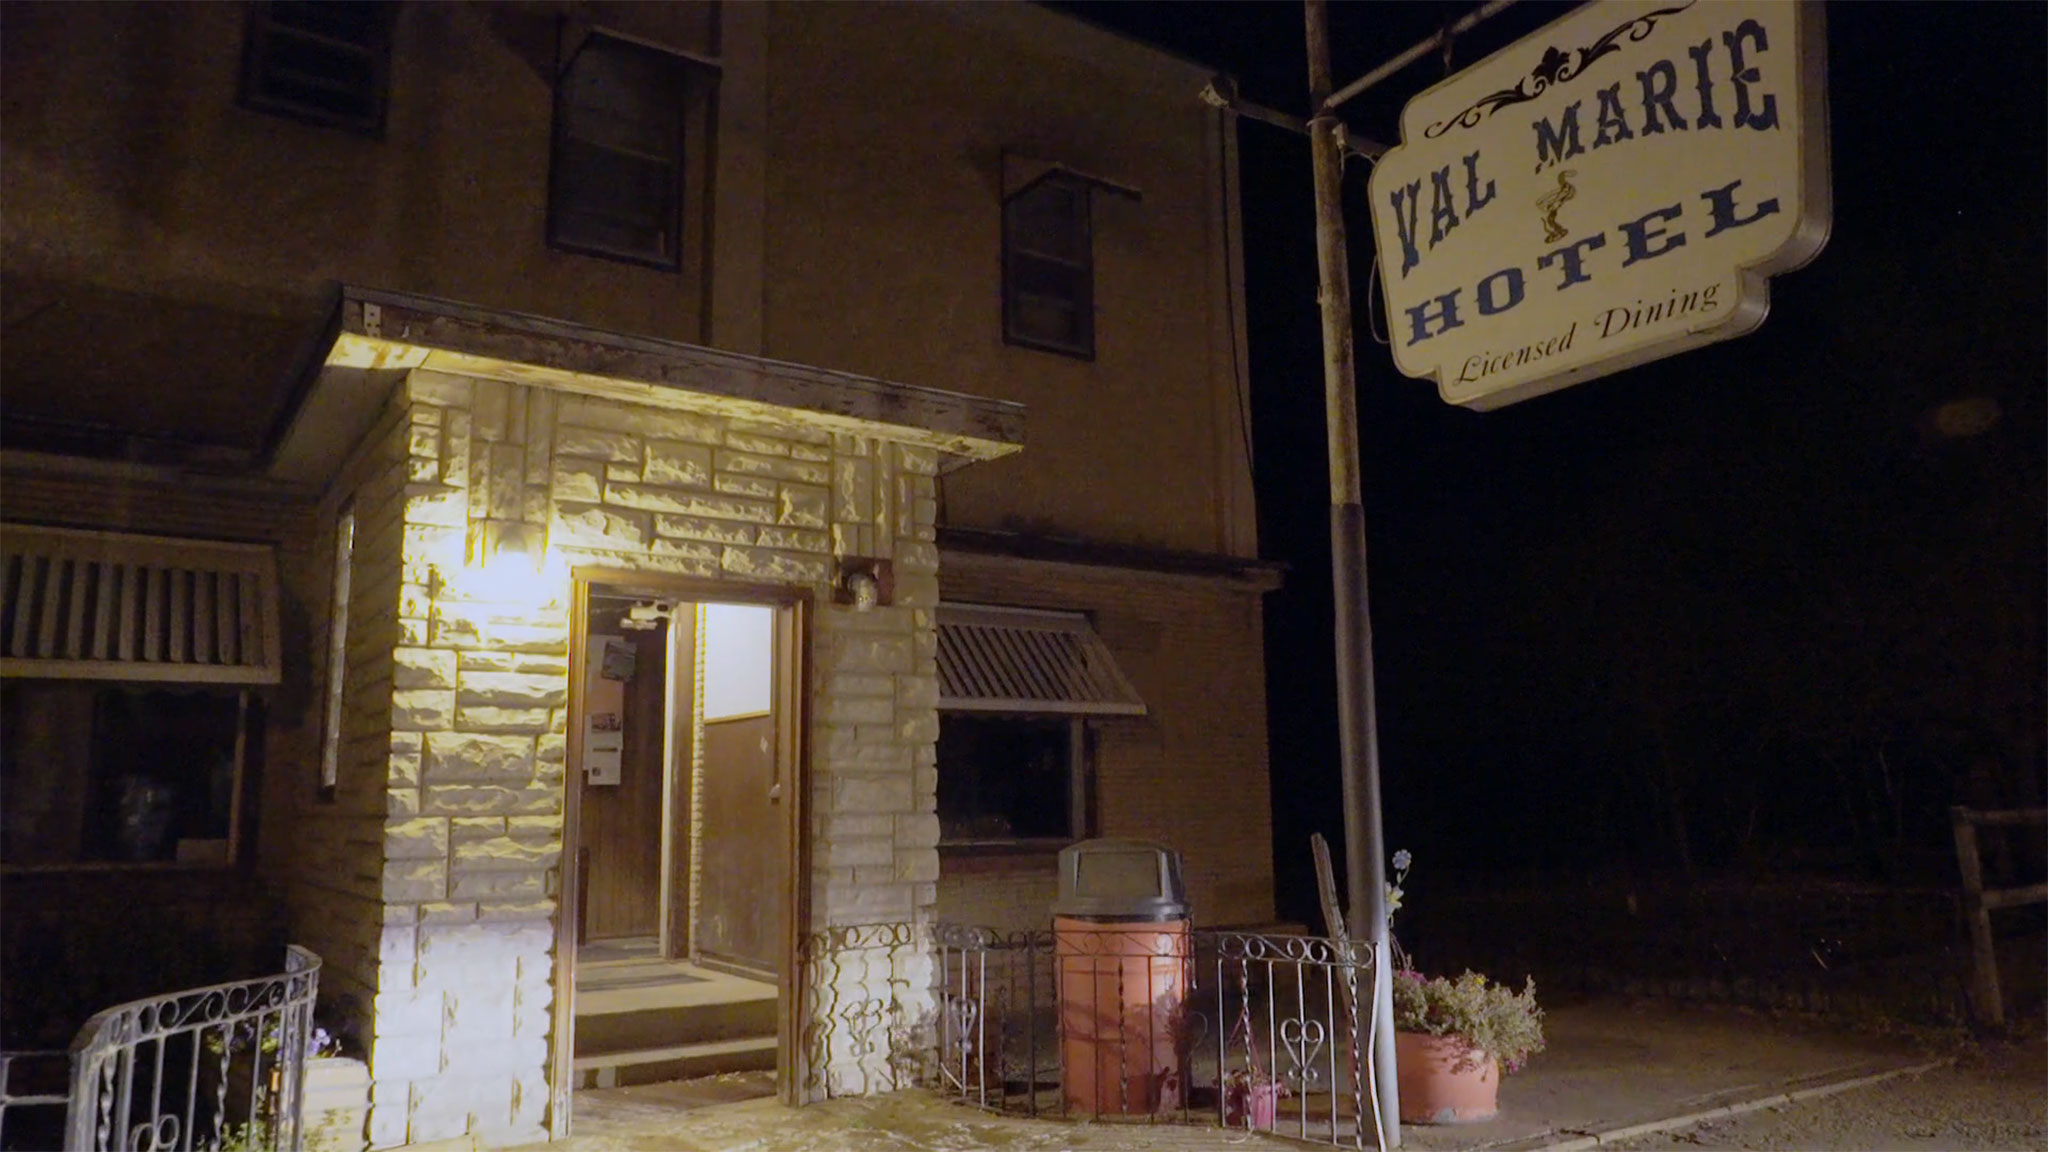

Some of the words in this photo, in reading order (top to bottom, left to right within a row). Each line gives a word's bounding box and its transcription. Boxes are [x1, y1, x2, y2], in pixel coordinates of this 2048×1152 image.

[1390, 149, 1496, 279] VAL
[1532, 18, 1780, 174] MARIE
[1405, 179, 1780, 347] HOTEL
[1452, 322, 1577, 386] Licensed
[1594, 282, 1721, 339] Dining
